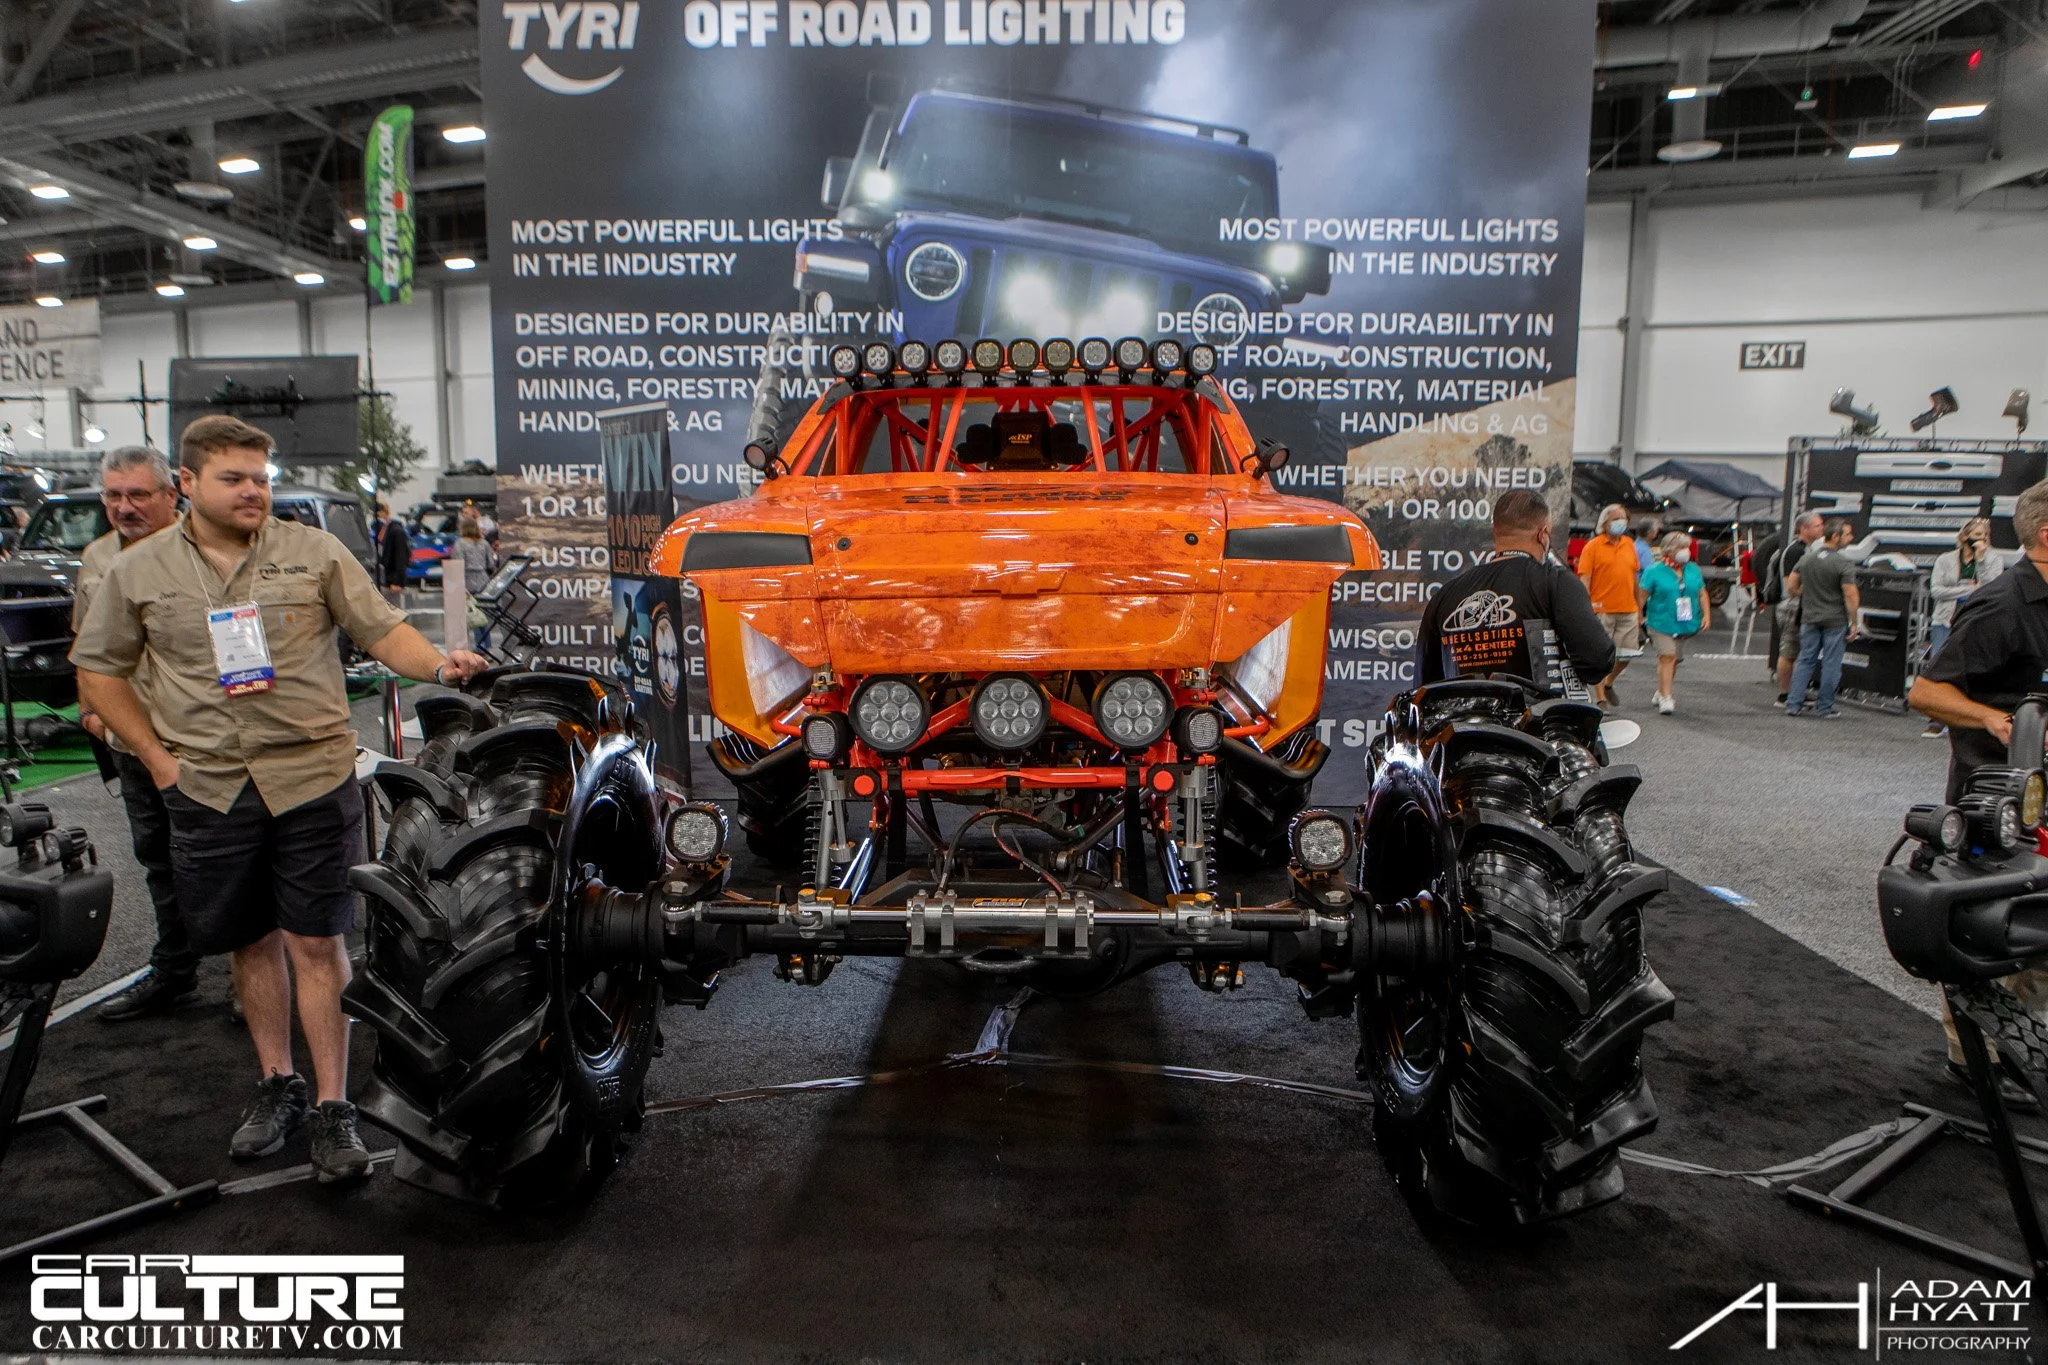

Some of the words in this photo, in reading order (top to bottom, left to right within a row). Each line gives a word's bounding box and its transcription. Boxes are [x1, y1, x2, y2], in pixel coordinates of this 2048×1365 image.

[503, 2, 640, 50] TYRI
[684, 0, 779, 48] OFF
[789, 0, 931, 47] ROAD
[944, 0, 1186, 46] LIGHTING
[511, 220, 589, 244] MOST
[596, 219, 743, 243] POWERFUL
[749, 218, 844, 242] LIGHTS
[1219, 219, 1298, 243] MOST
[1305, 218, 1454, 242] POWERFUL
[1461, 218, 1559, 242] LIGHTS
[513, 254, 540, 277] IN
[547, 253, 598, 276] THE
[605, 252, 737, 275] INDUSTRY
[1328, 253, 1355, 276] IN
[1362, 252, 1414, 276] THE
[1422, 252, 1558, 276] INDUSTRY
[515, 313, 649, 335] DESIGNED
[655, 312, 709, 335] FOR
[715, 312, 872, 334] DURABILITY
[878, 311, 904, 333] IN
[1157, 312, 1293, 335] DESIGNED
[1300, 312, 1352, 336] FOR
[1360, 312, 1520, 336] DURABILITY
[1527, 313, 1554, 336] IN
[516, 346, 568, 368] OFF
[574, 345, 653, 372] ROAD,
[660, 344, 829, 368] CONSTRUCTI
[1245, 345, 1326, 371] ROAD,
[1333, 346, 1553, 373] CONSTRUCTION,
[1745, 344, 1802, 367] EXIT
[518, 379, 621, 403] MINING,
[627, 378, 767, 402] FORESTRY,
[1262, 378, 1404, 404] FORESTRY,
[1416, 378, 1550, 402] MATERIAL
[685, 411, 722, 432] AG
[1340, 411, 1479, 434] HANDLING
[1485, 411, 1504, 434] &
[1510, 411, 1549, 434] AG
[603, 431, 665, 492] WIN
[672, 463, 710, 484] OU
[716, 463, 765, 484] NEE
[1276, 465, 1408, 488] WHETHER
[1414, 466, 1467, 488] YOU
[1475, 466, 1547, 490] NEED
[522, 496, 530, 518] 1
[539, 496, 578, 518] OR
[1384, 499, 1393, 520] 1
[1402, 499, 1439, 520] OR
[612, 551, 632, 574] LED
[1427, 550, 1463, 571] TO
[633, 645, 649, 662] TYRI
[1475, 640, 1516, 652] CENTER
